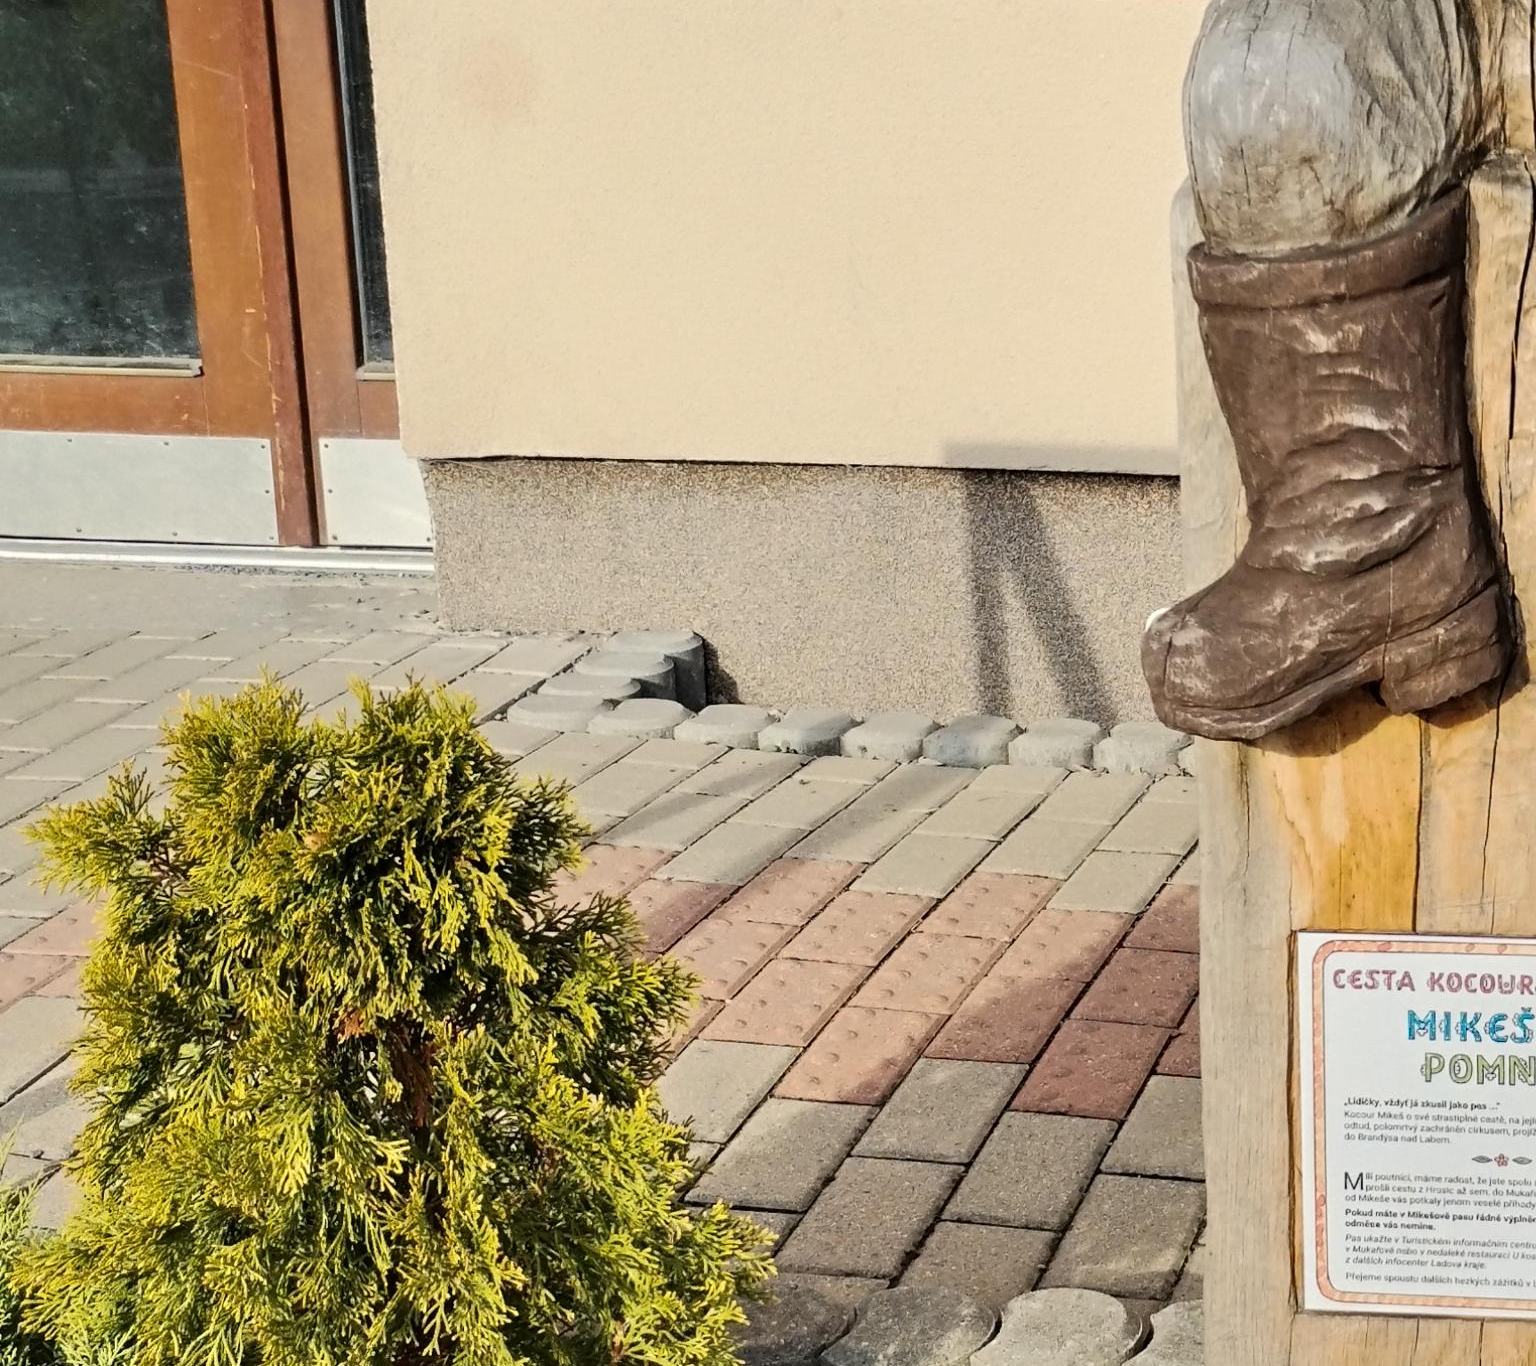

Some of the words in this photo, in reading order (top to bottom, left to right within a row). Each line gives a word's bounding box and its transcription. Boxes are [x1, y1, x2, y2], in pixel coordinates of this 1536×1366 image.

[1332, 968, 1415, 991] CESTA
[1384, 1098, 1408, 1108] vždyť
[1408, 1098, 1418, 1108] já
[1421, 1099, 1446, 1108] zkusil
[1449, 1100, 1468, 1110] jako
[1343, 1109, 1374, 1118] Kocour
[1377, 1111, 1404, 1119] Mikeš
[1414, 1112, 1429, 1120] své
[1431, 1113, 1478, 1124] strastiplné
[1480, 1114, 1506, 1125] cestě,
[1343, 1121, 1371, 1131] odtud,
[1467, 1125, 1510, 1136] cirkusem,
[1343, 1131, 1355, 1140] do
[1357, 1132, 1398, 1141] Brandýsa
[1400, 1134, 1417, 1142] nad
[1414, 1174, 1442, 1183] máme
[1444, 1175, 1474, 1185] radost,
[1477, 1176, 1487, 1184] že
[1488, 1177, 1505, 1186] jste
[1507, 1177, 1532, 1187] spolu
[1365, 1182, 1390, 1193] prošli
[1391, 1184, 1416, 1192] cestu
[1456, 1186, 1466, 1194] až
[1492, 1187, 1504, 1196] do
[1344, 1193, 1356, 1201] od
[1358, 1193, 1390, 1202] Mikeše
[1392, 1195, 1407, 1203] vás
[1409, 1195, 1441, 1206] potkaly
[1443, 1197, 1470, 1207] jenom
[1473, 1198, 1501, 1206] veselé
[1344, 1208, 1373, 1216] Pokud
[1375, 1209, 1397, 1217] máte
[1407, 1210, 1450, 1220] Mikešově
[1452, 1214, 1473, 1222] pasu
[1382, 1220, 1398, 1228] vás
[1400, 1221, 1435, 1230] nemine.
[1344, 1233, 1361, 1242] Pas
[1363, 1234, 1392, 1243] ukažte
[1402, 1236, 1451, 1245] Turistickém
[1453, 1238, 1507, 1248] informačním
[1510, 1240, 1536, 1249] centru
[1352, 1244, 1394, 1254] Mukařově
[1426, 1247, 1465, 1257] nedaleké
[1512, 1251, 1519, 1259] U
[1352, 1255, 1383, 1264] dalších
[1385, 1257, 1428, 1266] infocenter
[1430, 1258, 1462, 1267] Ladova
[1345, 1271, 1381, 1282] Přejeme
[1383, 1273, 1419, 1283] spoustu
[1420, 1274, 1452, 1283] dalších
[1454, 1276, 1490, 1285] hezkých
